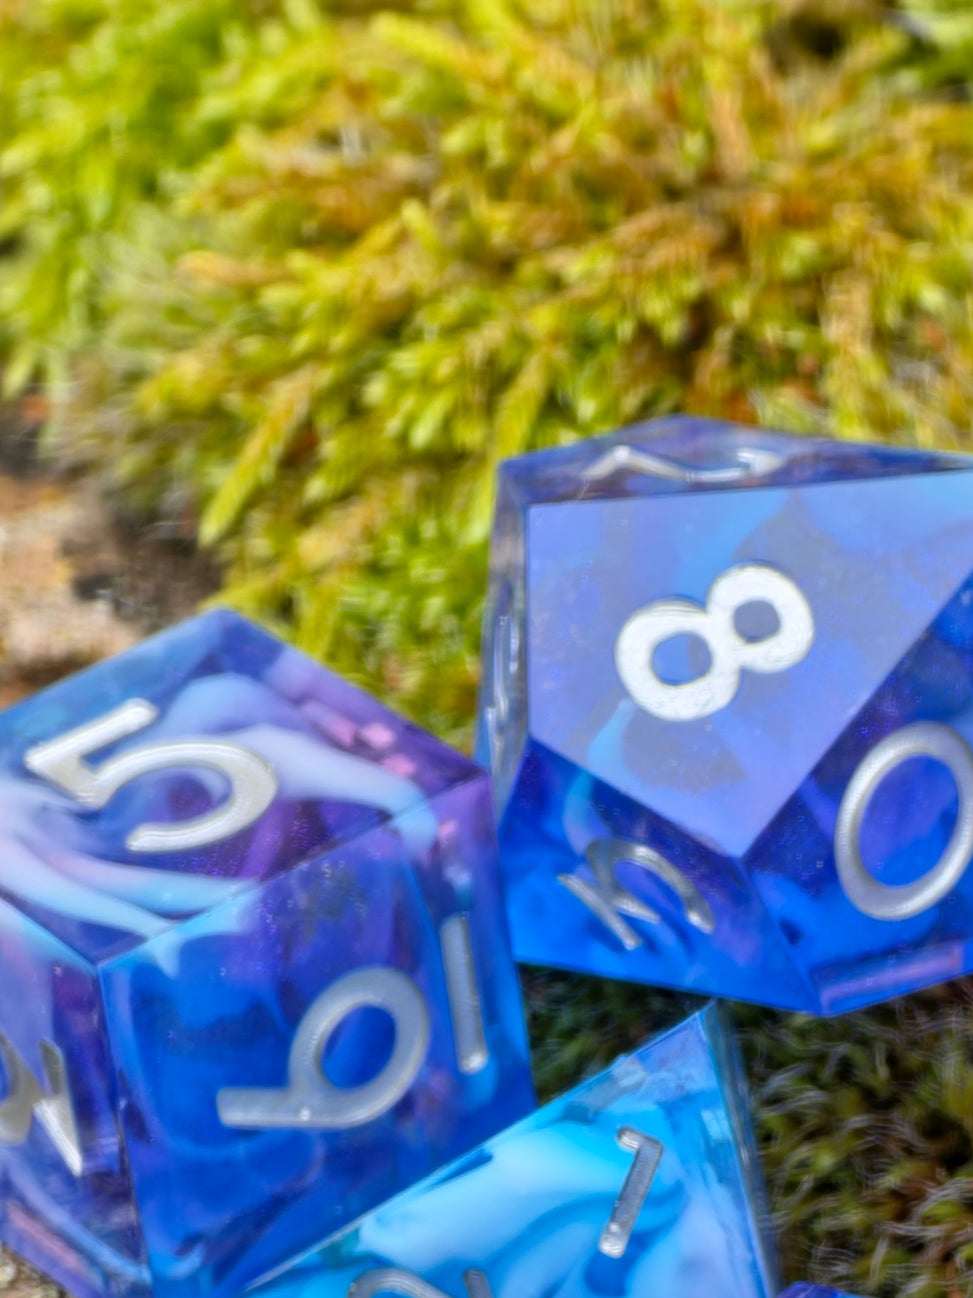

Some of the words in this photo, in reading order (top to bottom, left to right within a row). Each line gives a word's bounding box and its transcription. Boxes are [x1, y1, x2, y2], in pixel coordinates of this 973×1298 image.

[614, 563, 815, 722] 8
[24, 698, 278, 854] 5
[599, 1126, 664, 1259] 1
